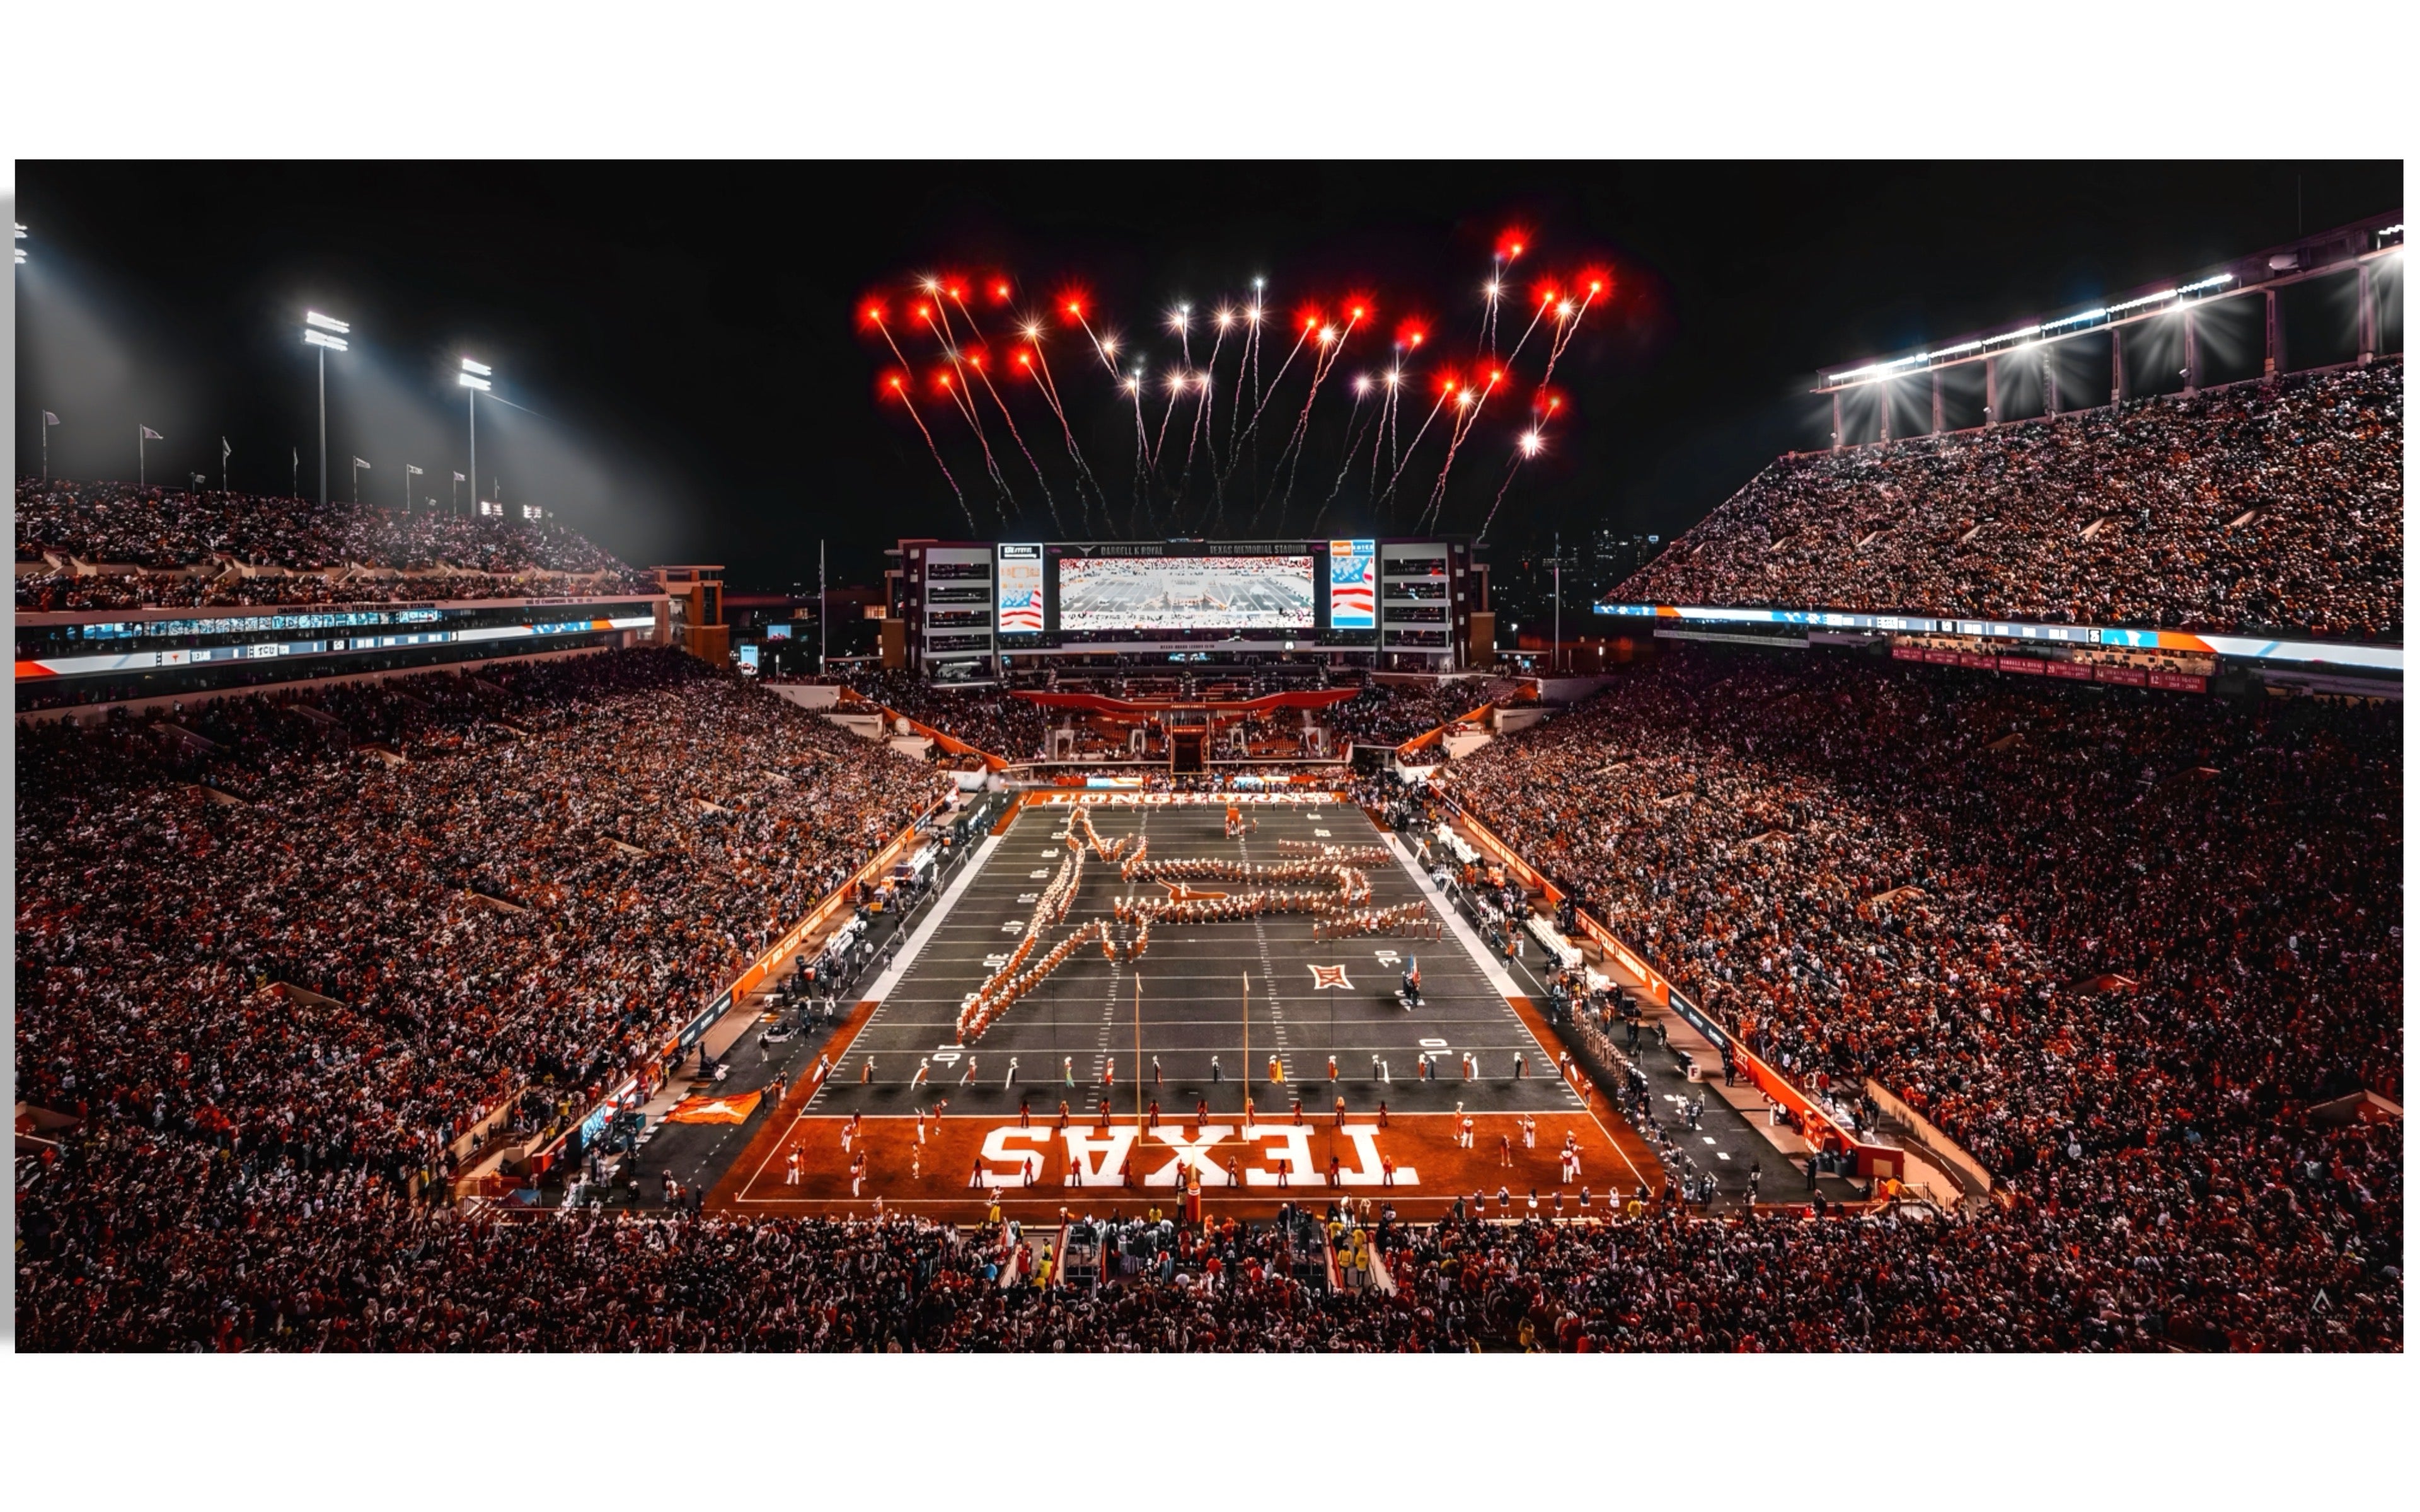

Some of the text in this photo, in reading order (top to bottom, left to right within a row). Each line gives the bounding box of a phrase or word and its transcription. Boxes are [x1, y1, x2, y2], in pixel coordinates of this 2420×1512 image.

[1100, 546, 1163, 556] DARRELL K ROYAL
[1209, 544, 1307, 554] TEXAS MEMORIAL STADIUM
[258, 646, 275, 655] TCU
[2150, 674, 2160, 685] 12
[983, 953, 1010, 967] 30
[1374, 950, 1402, 964] 30
[932, 1043, 966, 1062] 10
[1419, 1038, 1453, 1055] 10
[1691, 1067, 1698, 1077] F
[968, 1125, 1420, 1186] TEXAS
